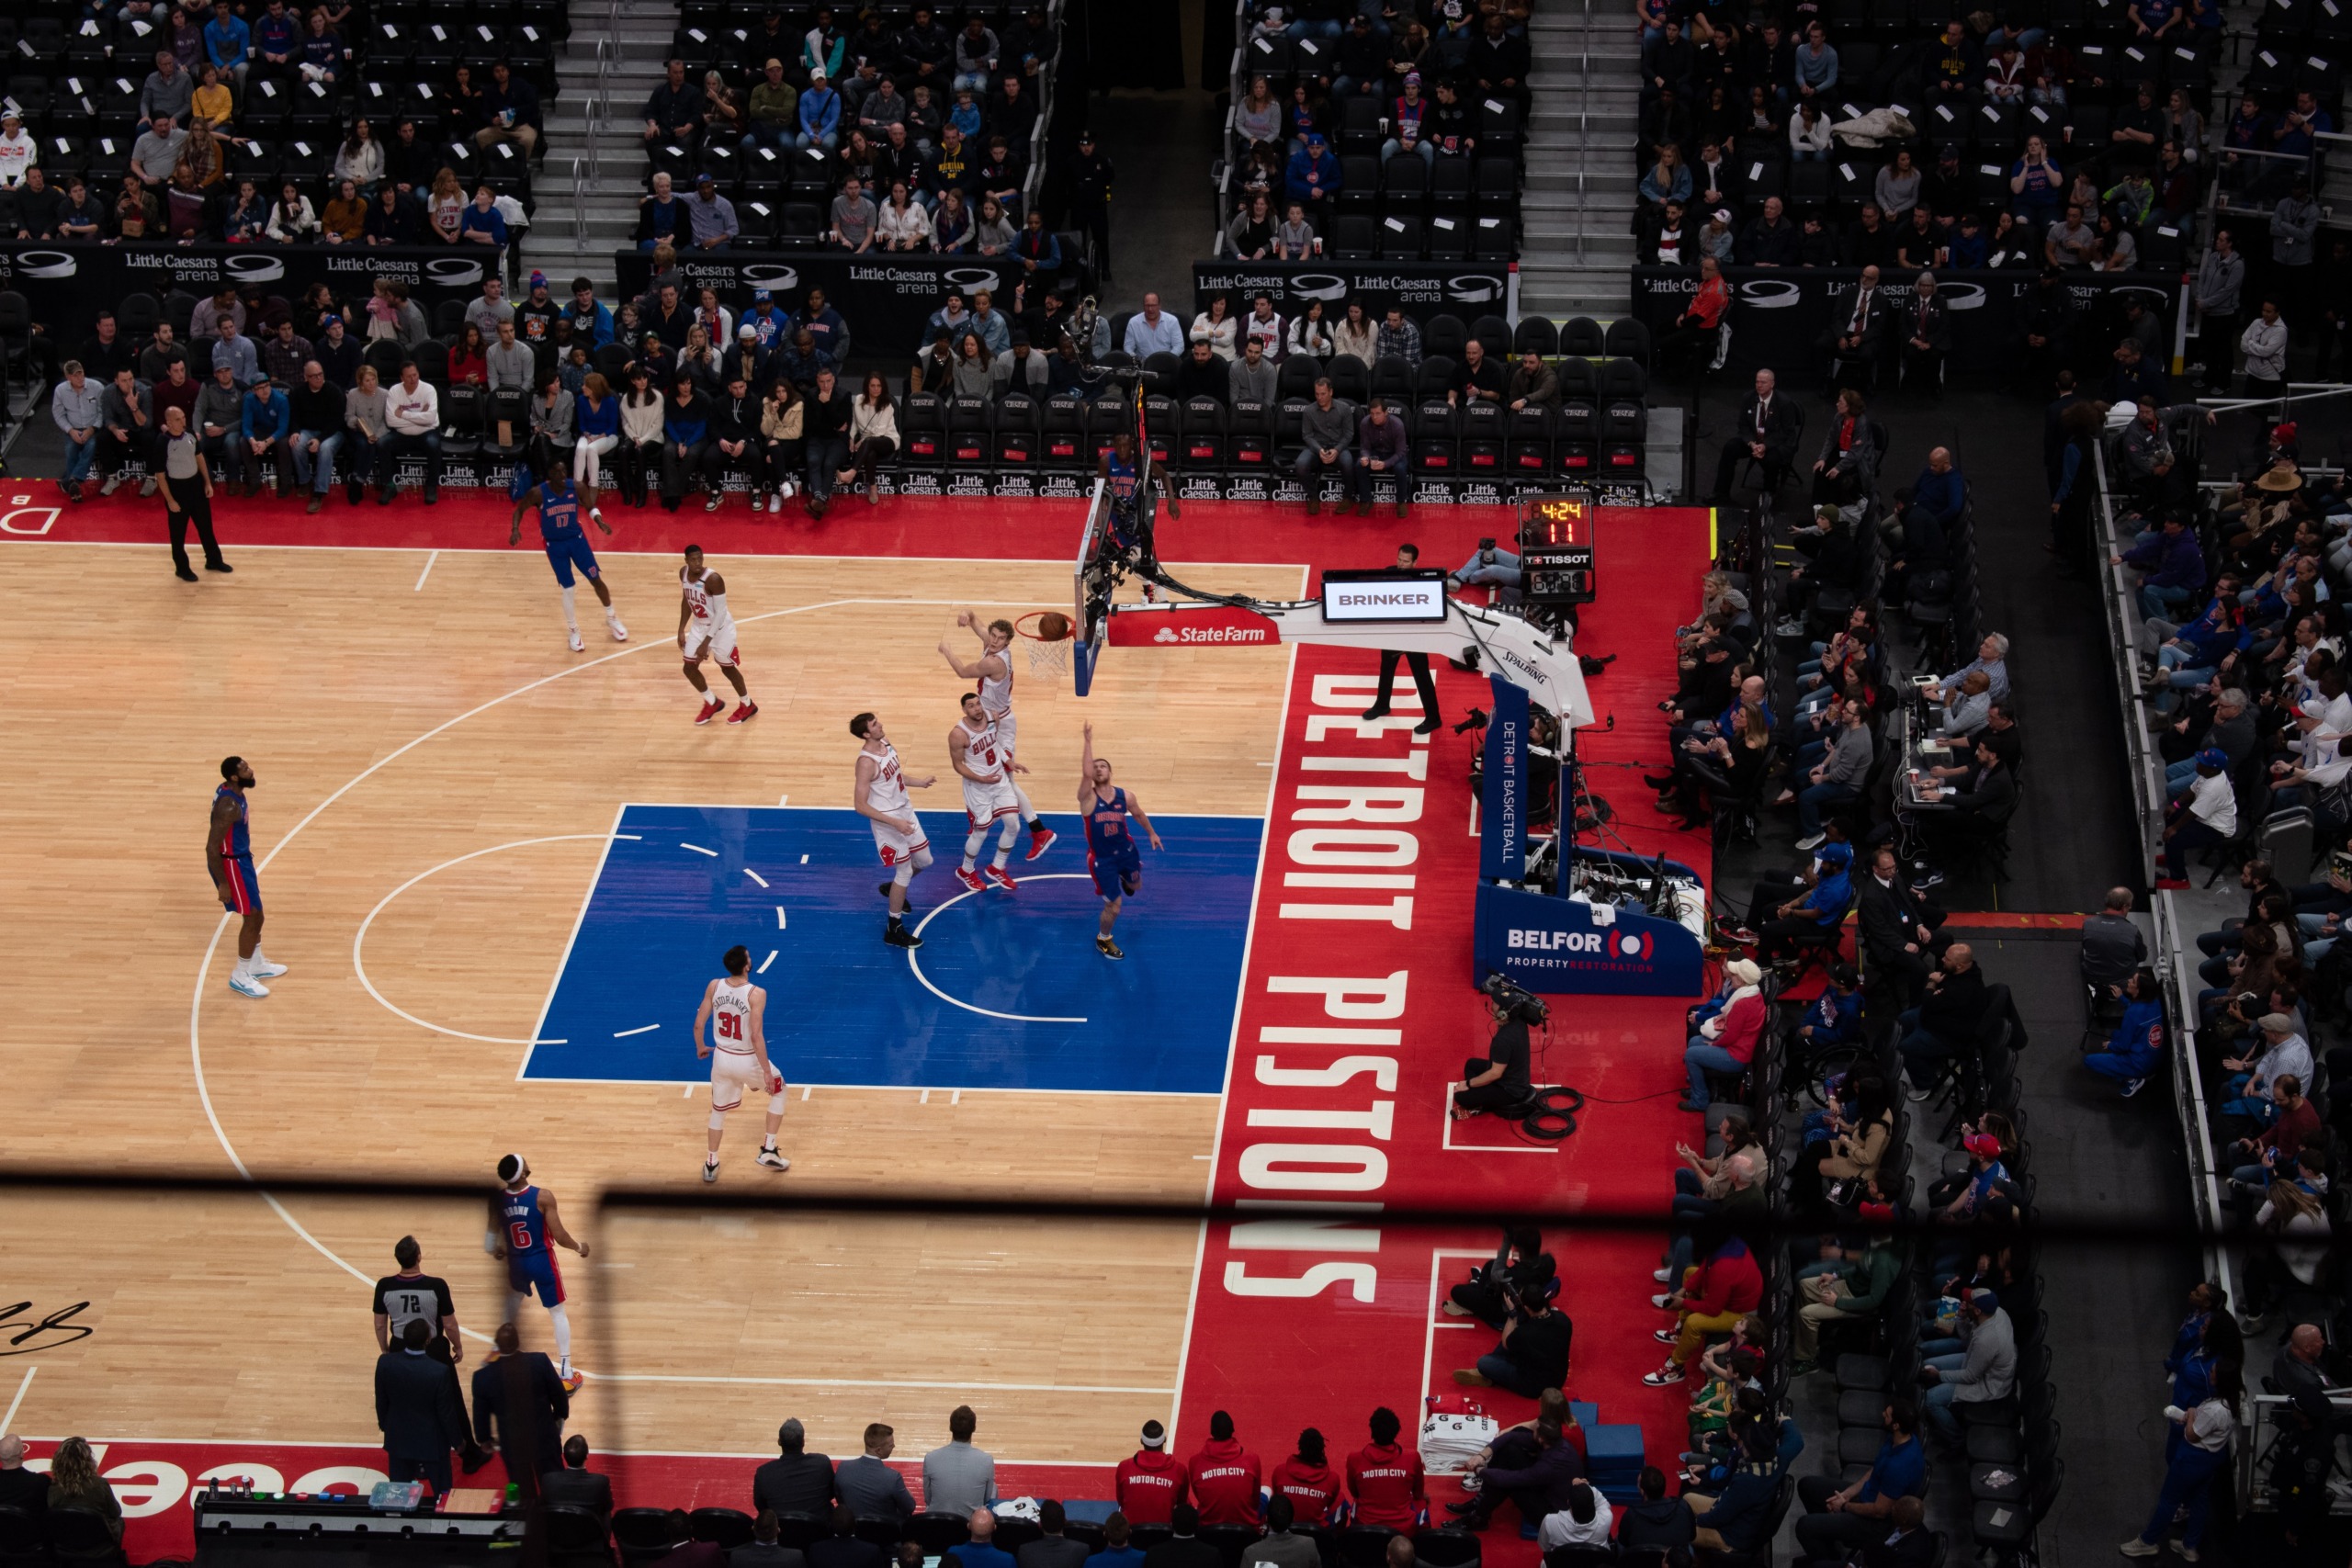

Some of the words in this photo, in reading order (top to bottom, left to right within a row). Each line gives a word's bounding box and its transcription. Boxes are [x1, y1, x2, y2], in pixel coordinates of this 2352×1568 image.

[125, 254, 163, 268] Little
[164, 254, 218, 270] Caesars
[327, 257, 364, 272] Little
[366, 258, 419, 273] Caesars
[175, 269, 219, 282] arena
[685, 263, 735, 276] Caesars
[849, 266, 884, 281] Little
[886, 268, 937, 282] Caesars
[696, 277, 736, 288] arena
[896, 283, 937, 294] arena
[1199, 276, 1233, 290] Little
[1234, 274, 1283, 288] Caesars
[1354, 276, 1389, 290] Little
[1390, 276, 1441, 290] Caesars
[1400, 290, 1441, 303] arena
[447, 466, 474, 478] Little
[723, 471, 752, 483] Little
[392, 473, 427, 485] Caesar
[438, 475, 480, 487] Caesars
[909, 474, 937, 486] Little
[956, 475, 984, 487] Little
[1001, 476, 1031, 487] Little
[1047, 476, 1076, 488] Little
[1187, 478, 1216, 491] Little
[1235, 479, 1262, 491] Little
[900, 483, 942, 495] Caesars
[946, 484, 988, 496] Caesars
[993, 485, 1035, 497] Caesars
[1038, 486, 1080, 498] Caesars
[1114, 485, 1132, 497] 45
[1179, 488, 1220, 500] Caesars
[1374, 482, 1396, 494] Littl
[1421, 483, 1450, 495] Little
[1468, 483, 1497, 496] Little
[1608, 485, 1637, 498] Little
[1226, 489, 1267, 501] Caesars
[1272, 490, 1310, 502] Caesar
[1413, 492, 1453, 504] Caesars
[1459, 492, 1500, 505] Caesars
[1599, 495, 1641, 507] Caesars
[1542, 502, 1581, 521] 4:24
[556, 514, 570, 528] 17
[1542, 555, 1589, 565] TISSOT
[685, 588, 707, 606] ULLS
[1339, 593, 1430, 606] BRINKER
[1502, 651, 1547, 685] SPALDING
[1503, 721, 1516, 776] DETROIT
[985, 748, 996, 766] 8
[882, 755, 900, 783] BULL
[1279, 669, 1438, 930] DETROIT
[1503, 781, 1514, 863] BASKETBALL
[1508, 929, 1602, 953] BELFOR
[1507, 957, 1569, 969] PROPERTY
[1569, 961, 1653, 974] RESTORATION
[713, 996, 750, 1016] SATORANSKY
[718, 1011, 742, 1041] 31
[1224, 969, 1408, 1303] PISTONS
[504, 1205, 529, 1218] BROWN
[509, 1221, 533, 1249] 6
[401, 1295, 421, 1314] 72
[1202, 1468, 1227, 1480] MOTOR
[1227, 1468, 1246, 1477] CITY
[1362, 1470, 1387, 1479] MOTOR
[1389, 1469, 1406, 1478] CITY
[1129, 1475, 1155, 1486] MOTOR
[1156, 1477, 1173, 1488] CITY
[1283, 1485, 1308, 1495] MOTOR
[1309, 1487, 1327, 1498] CITY
